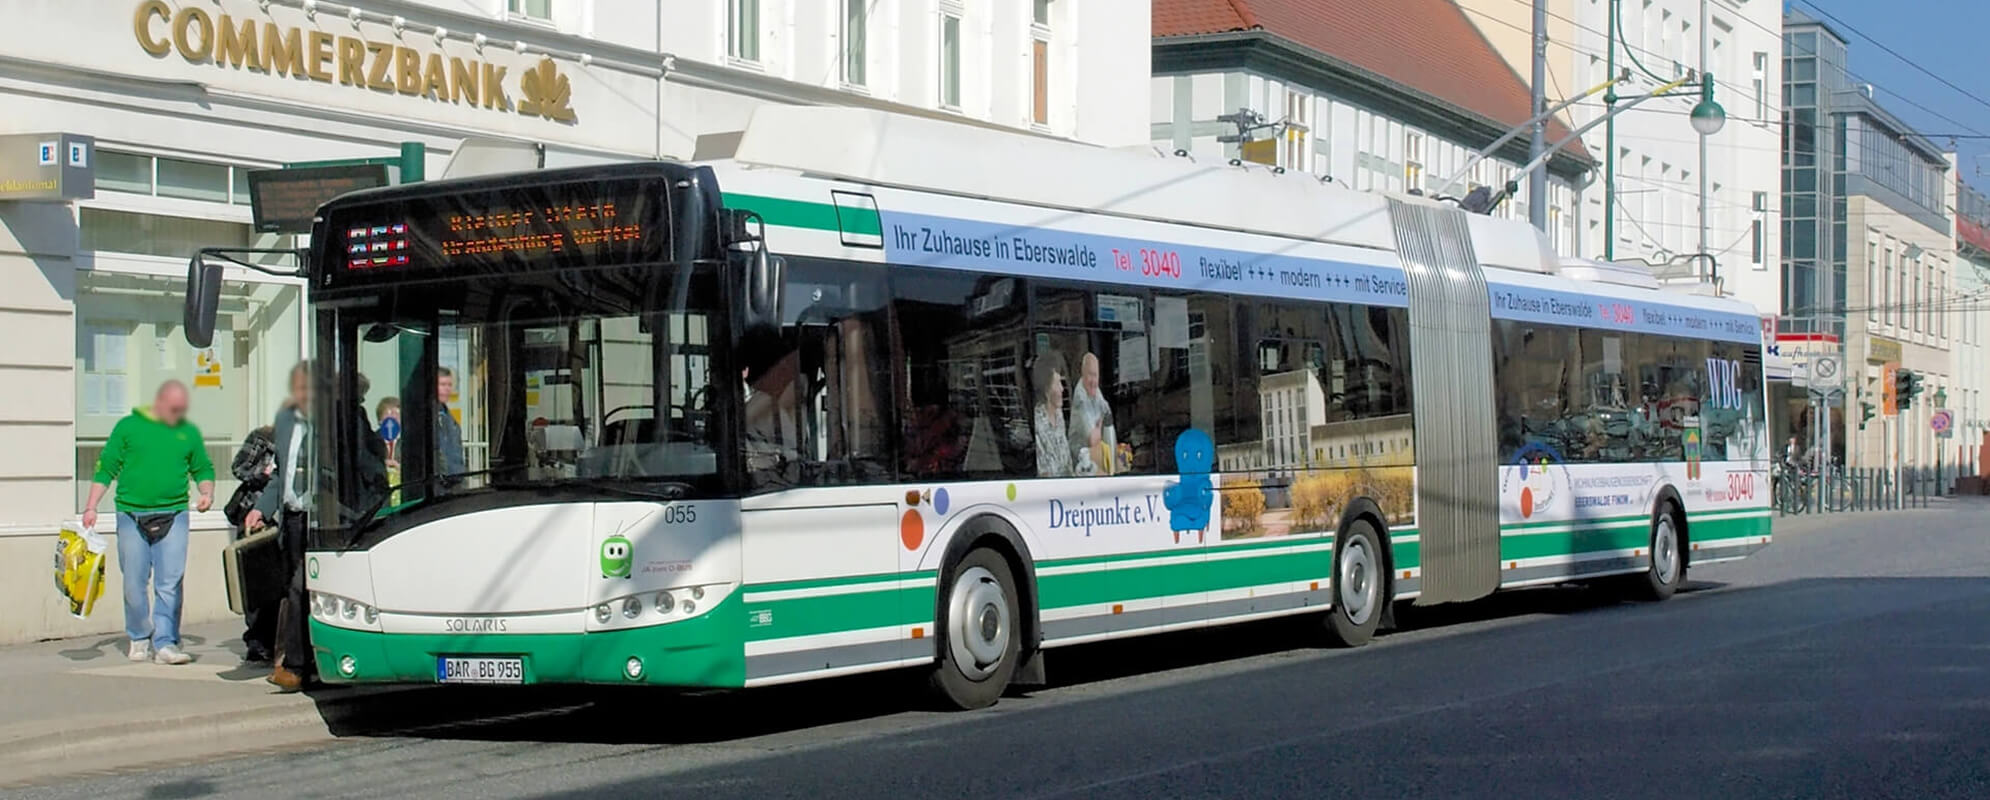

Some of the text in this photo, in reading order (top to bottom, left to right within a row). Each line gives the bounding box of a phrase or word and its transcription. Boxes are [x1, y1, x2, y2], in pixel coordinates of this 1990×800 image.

[133, 0, 510, 111] COMMERZBANK
[893, 224, 918, 250] Ihr
[921, 227, 991, 258] Zuhause
[994, 236, 1009, 260] in
[1014, 238, 1097, 268] Eberswalde
[1112, 248, 1134, 271] Tel.
[1140, 249, 1181, 278] 3040
[1199, 256, 1242, 280] flexibel
[1280, 267, 1320, 288] modern
[1355, 274, 1370, 292] mit
[1372, 274, 1407, 296] Service
[1507, 293, 1541, 312] Zuhause
[1551, 298, 1592, 318] Eberswalde
[1706, 357, 1742, 410] WBG
[1728, 473, 1754, 501] 3040
[665, 504, 696, 524] 055
[1048, 495, 1161, 537] Dreipunkt e.V.
[446, 618, 507, 632] SOLARIS
[447, 661, 520, 678] BAR BG 955
